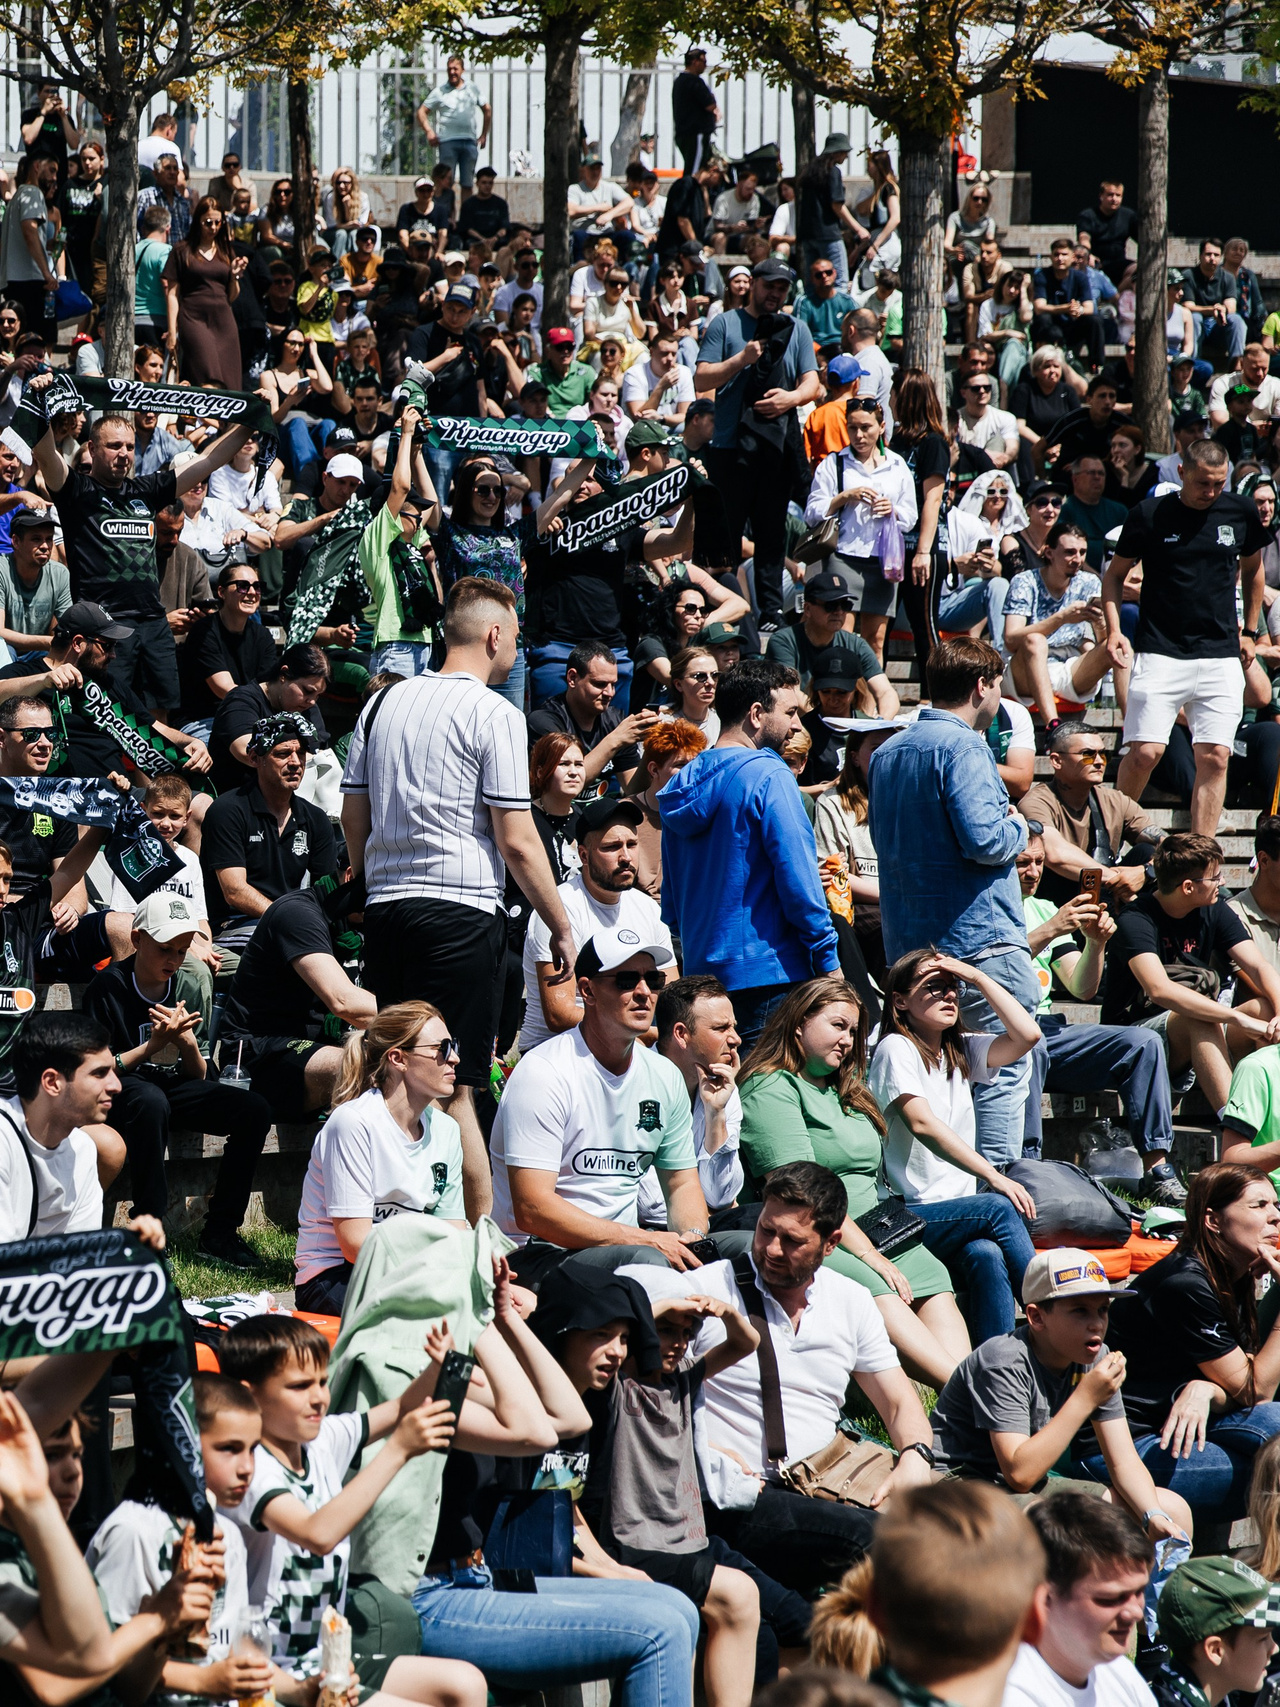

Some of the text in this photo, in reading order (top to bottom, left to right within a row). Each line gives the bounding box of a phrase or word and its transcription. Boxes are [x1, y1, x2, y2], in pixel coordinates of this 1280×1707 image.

[107, 378, 248, 419] Краснодар
[437, 418, 571, 455] Краснодар
[106, 522, 147, 535] Winline
[1074, 1100, 1085, 1110] 21
[583, 1154, 636, 1172] Winline
